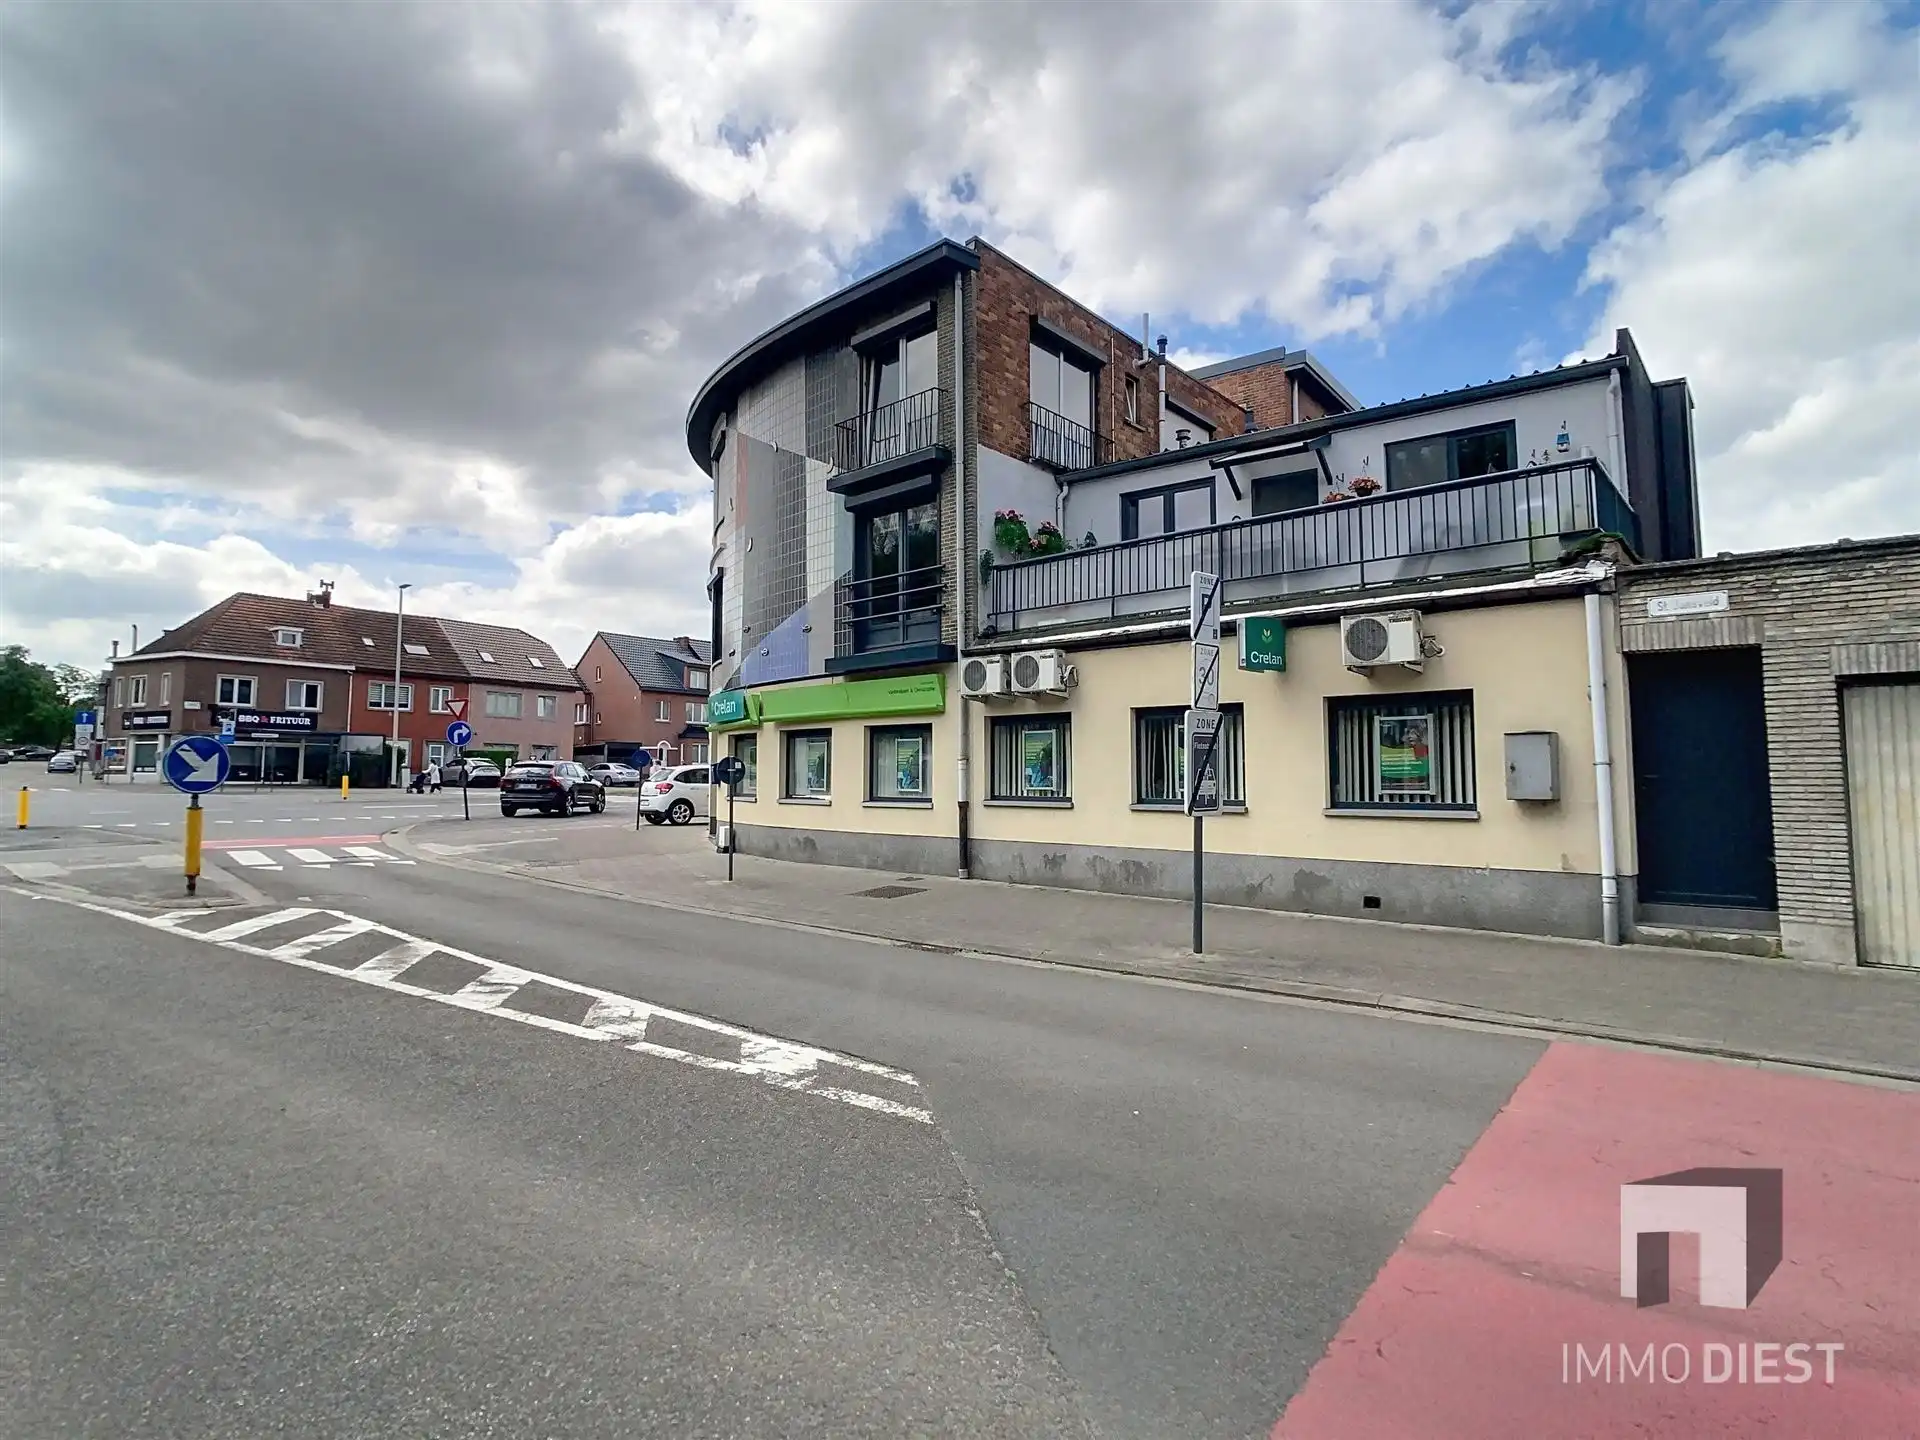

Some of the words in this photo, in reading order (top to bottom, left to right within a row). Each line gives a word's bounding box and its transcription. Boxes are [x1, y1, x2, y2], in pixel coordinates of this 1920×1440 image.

[1200, 576, 1214, 586] ZONE
[1200, 646, 1214, 657] ZONE
[1250, 651, 1283, 665] Crelan
[1199, 666, 1214, 686] 30
[714, 699, 736, 716] Crelan
[238, 714, 260, 723] BBQ
[270, 716, 311, 725] FRITUUR
[1196, 718, 1216, 730] ZONE
